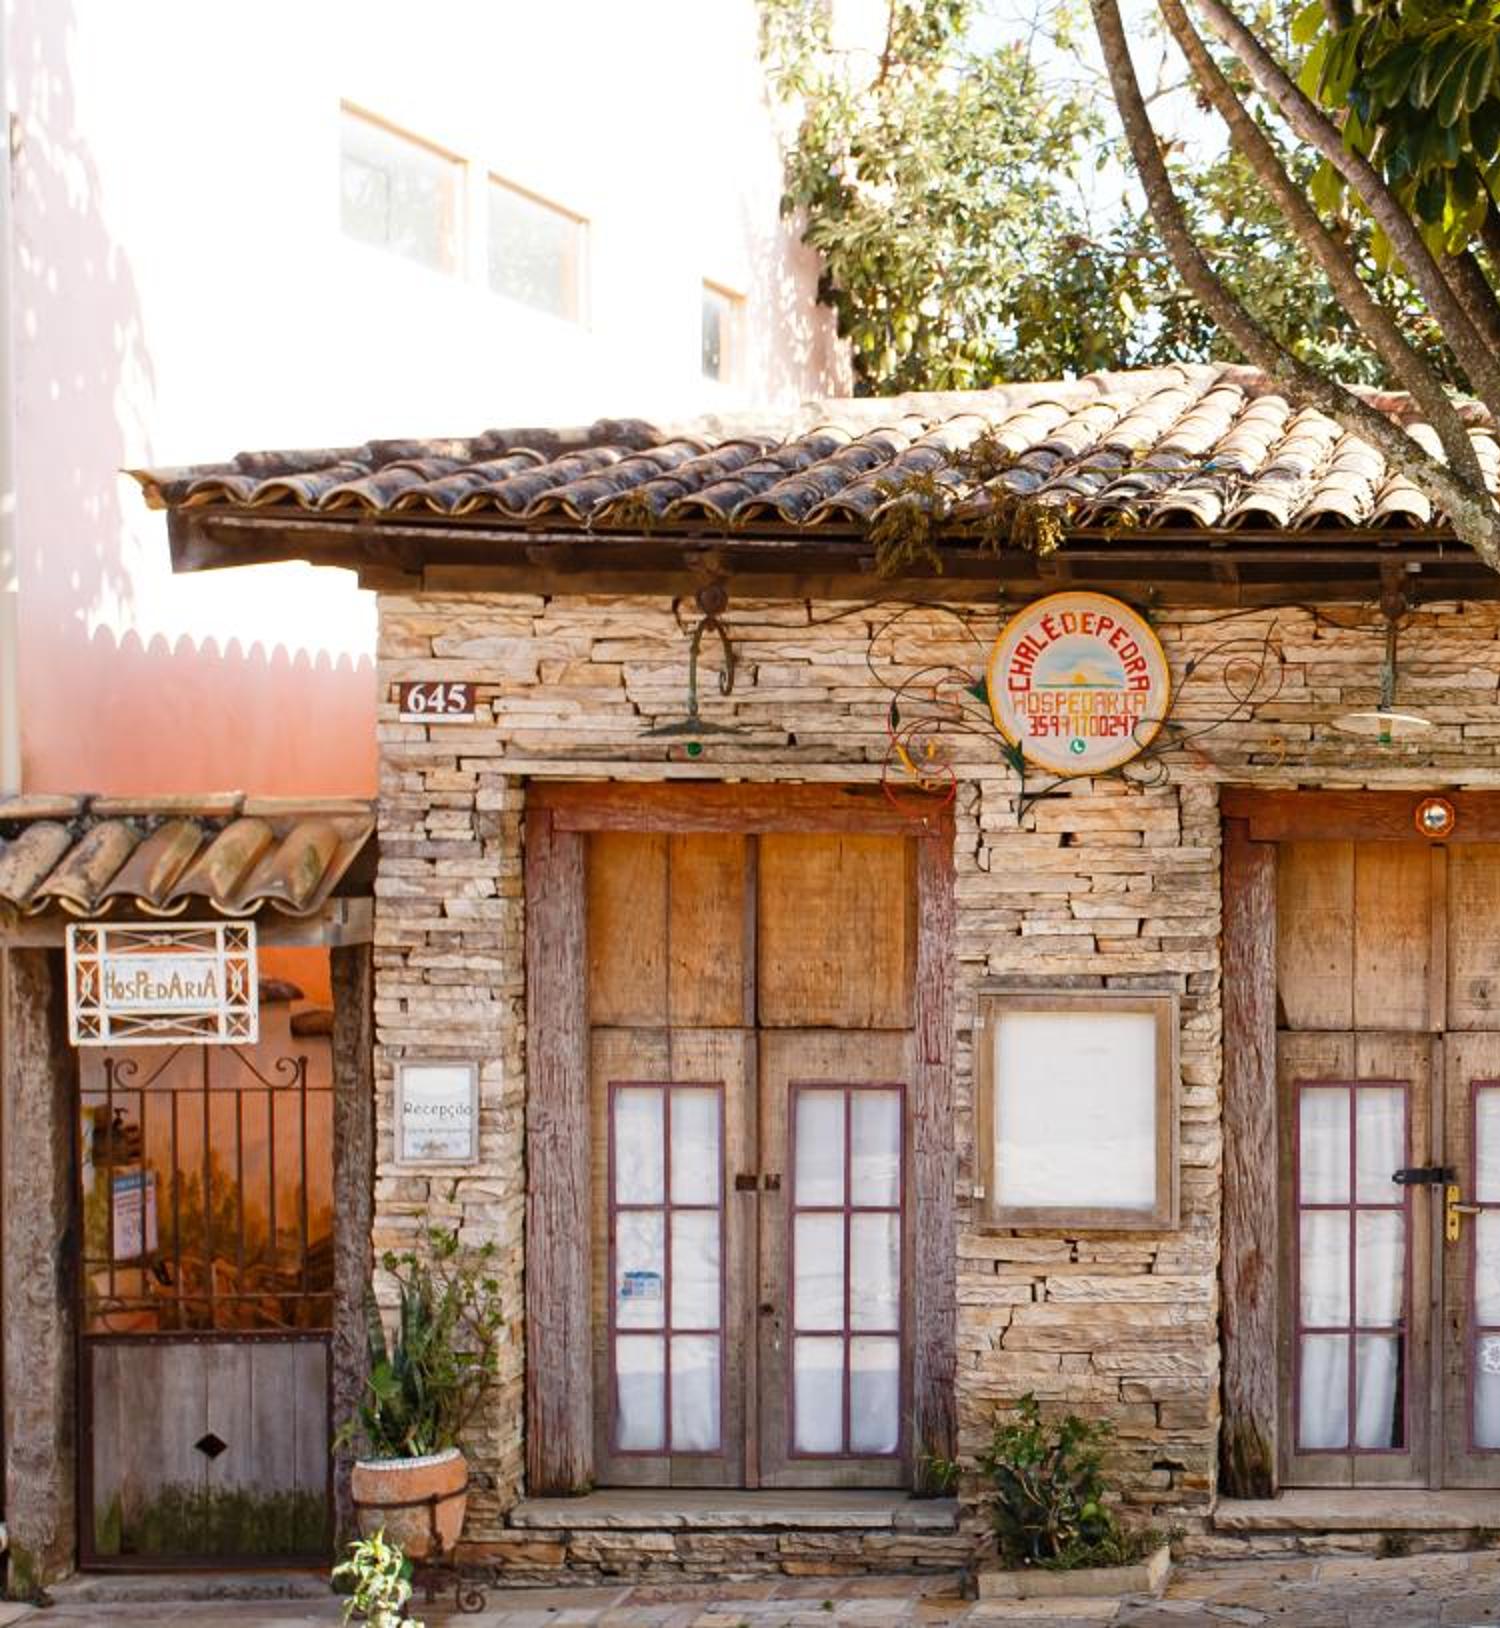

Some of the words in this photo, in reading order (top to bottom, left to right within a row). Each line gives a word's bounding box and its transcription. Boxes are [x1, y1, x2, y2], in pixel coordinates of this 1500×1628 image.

[1060, 611, 1095, 635] DE
[1096, 615, 1150, 691] PEDRA
[407, 683, 467, 713] 645
[1012, 692, 1147, 715] HOSPEDARIA
